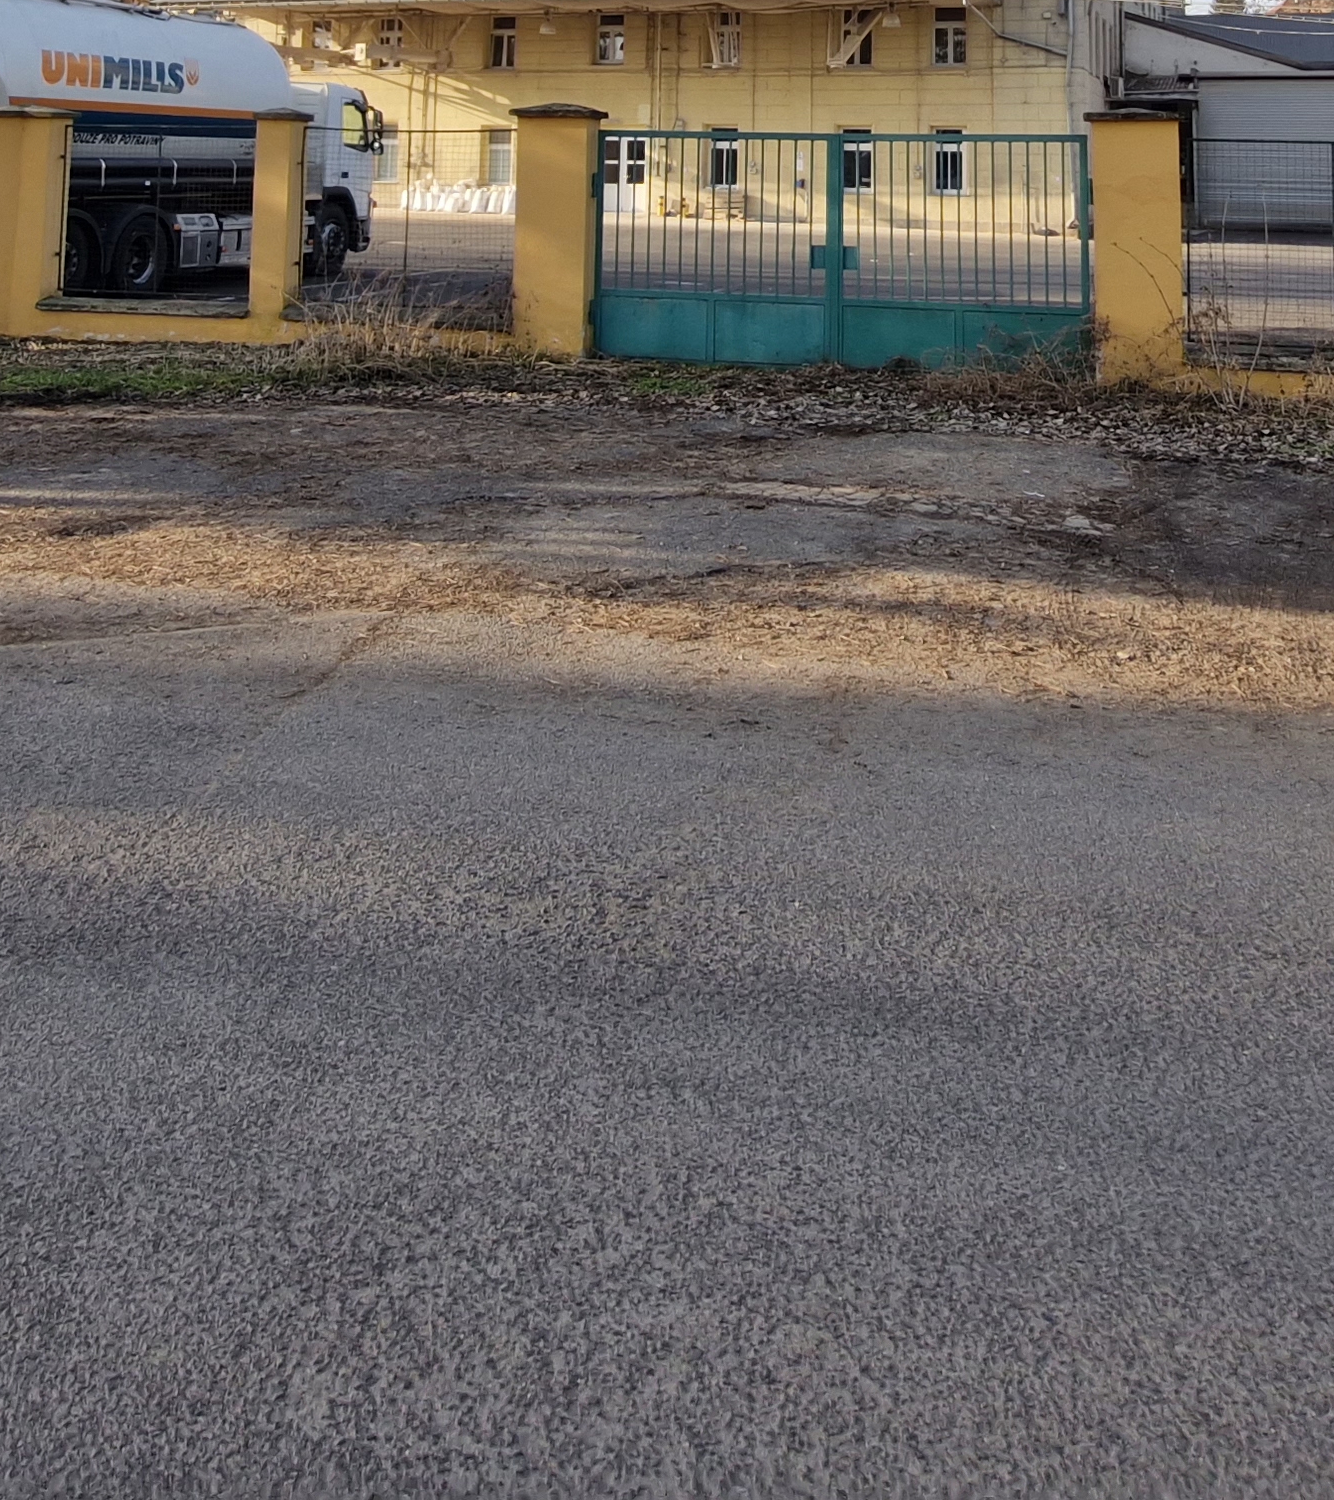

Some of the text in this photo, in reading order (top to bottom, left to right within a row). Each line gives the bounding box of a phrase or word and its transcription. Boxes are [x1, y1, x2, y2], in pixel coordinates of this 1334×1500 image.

[41, 49, 185, 95] UNIMILLS
[73, 133, 100, 144] OUZE
[98, 133, 119, 145] PRO
